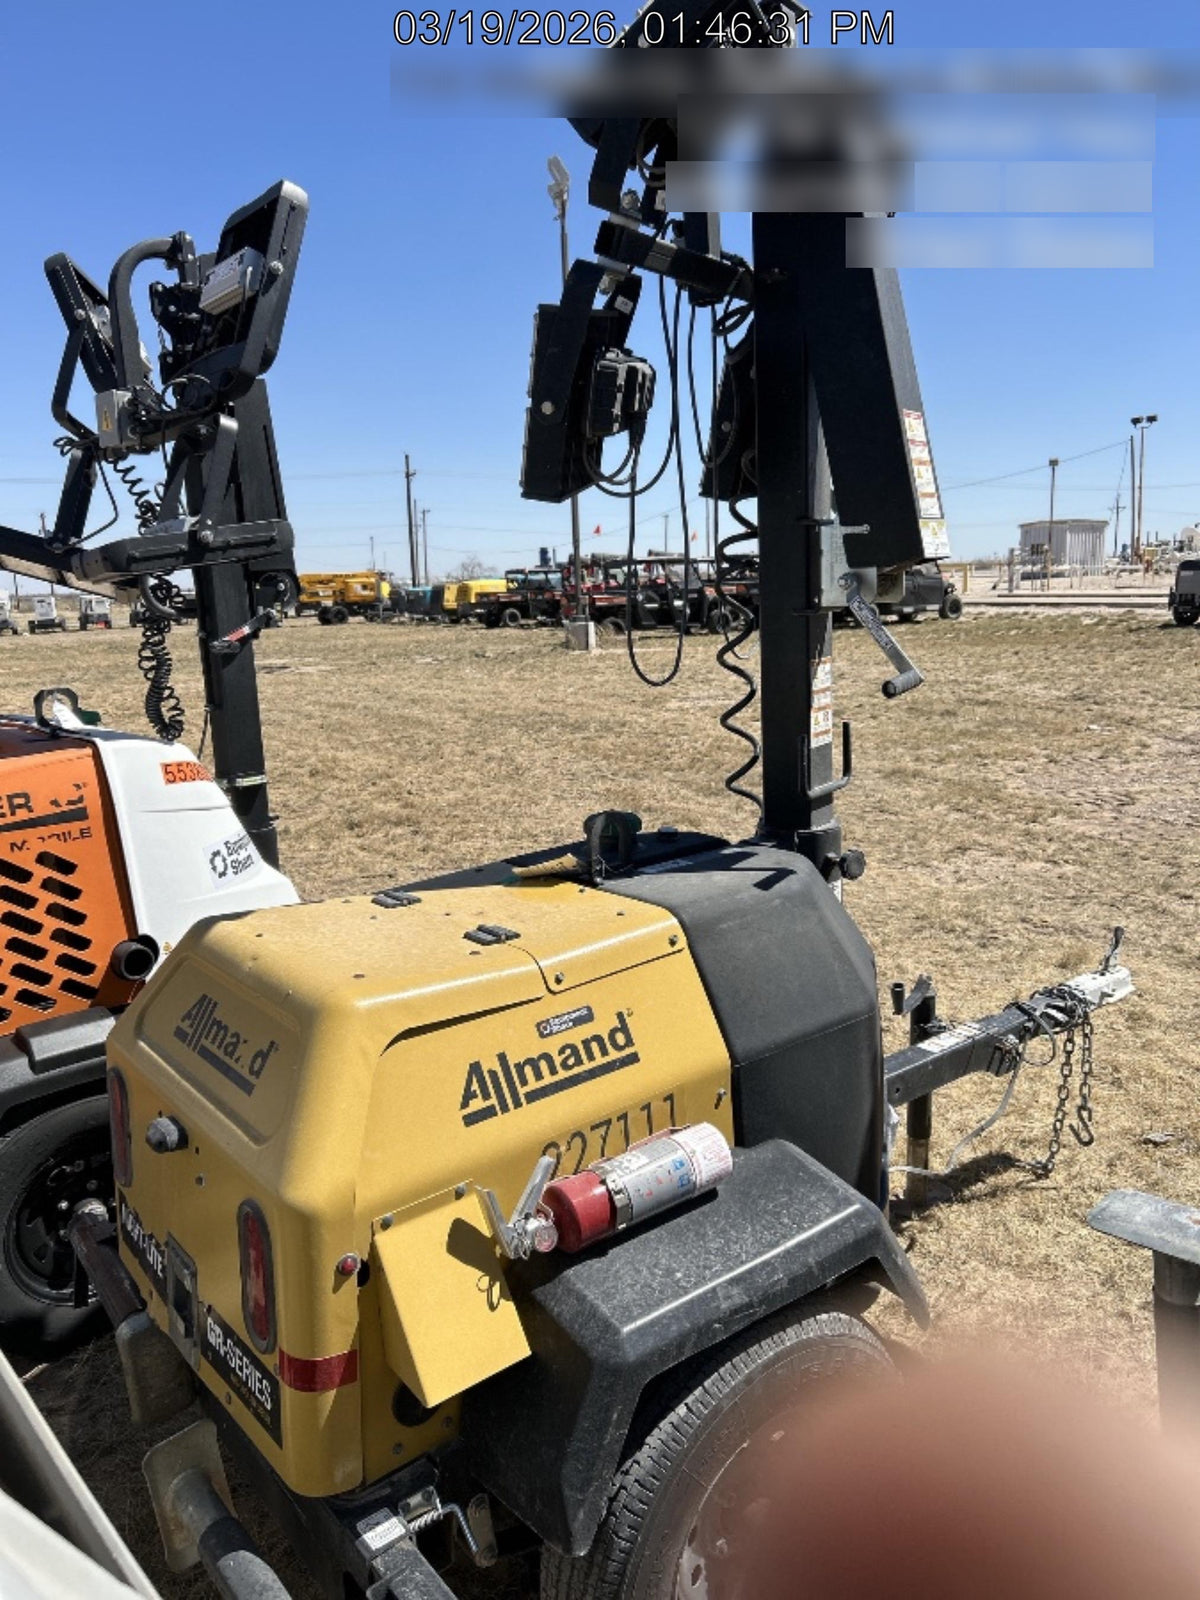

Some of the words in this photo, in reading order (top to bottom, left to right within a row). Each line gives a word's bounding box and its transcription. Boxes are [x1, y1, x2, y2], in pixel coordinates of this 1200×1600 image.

[164, 760, 213, 784] 553
[459, 1010, 635, 1115] Allmand
[207, 1316, 272, 1412] GR-SERIES
